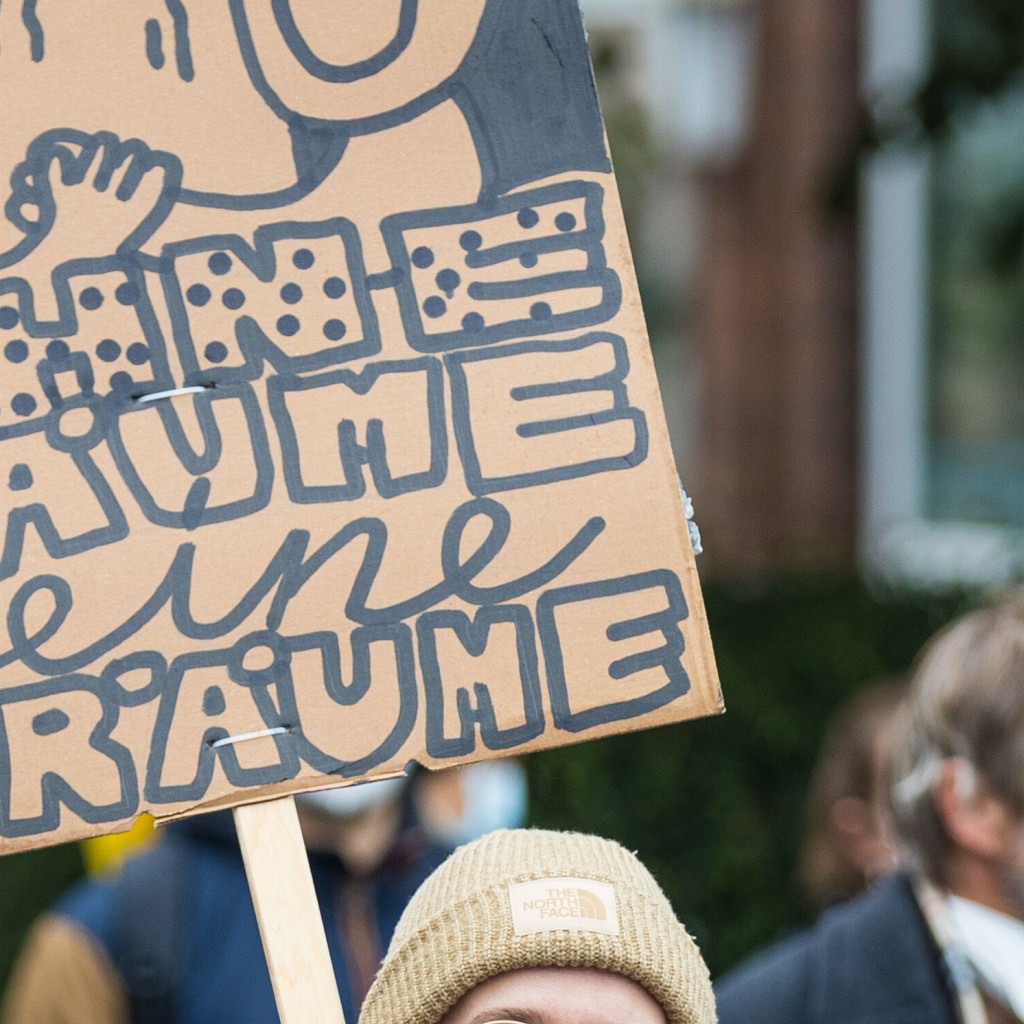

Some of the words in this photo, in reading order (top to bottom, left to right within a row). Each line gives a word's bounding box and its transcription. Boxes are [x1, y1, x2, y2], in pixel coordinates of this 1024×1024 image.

[545, 888, 577, 899] THE
[522, 897, 579, 912] NORTH
[540, 907, 580, 920] FACE
